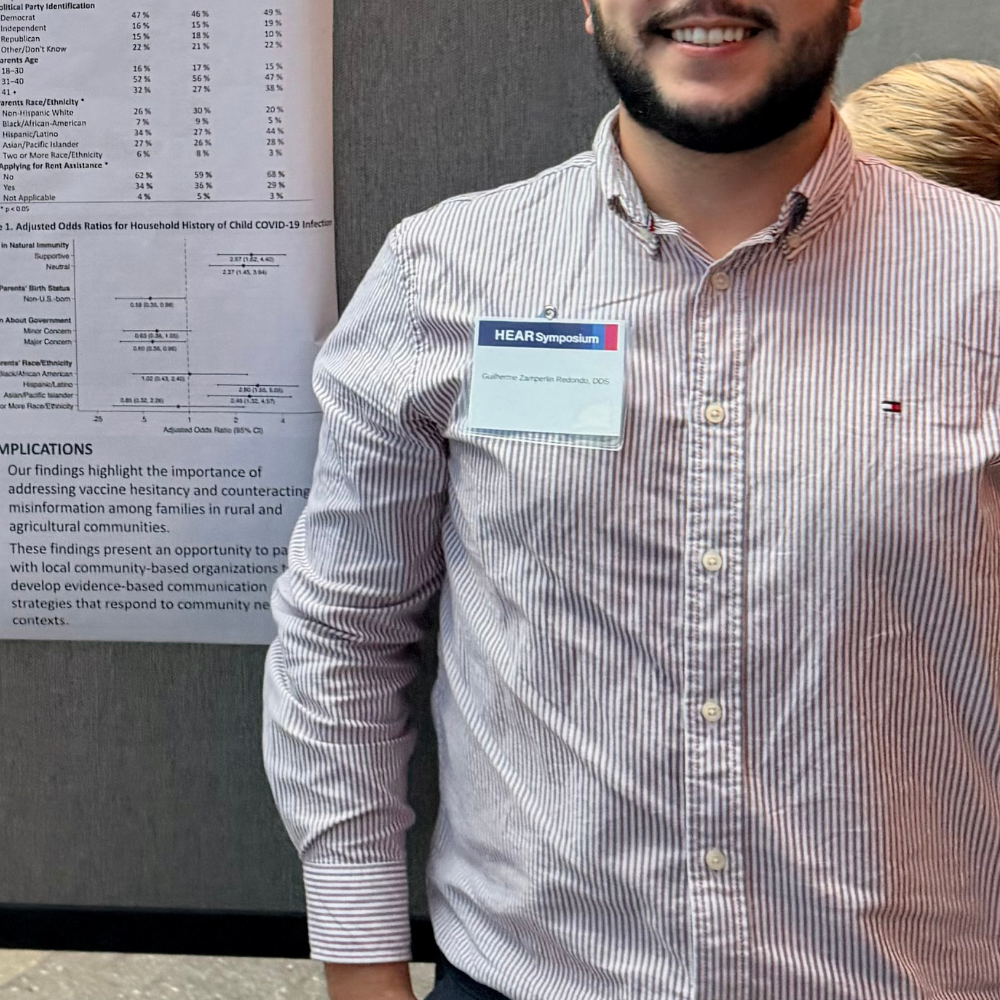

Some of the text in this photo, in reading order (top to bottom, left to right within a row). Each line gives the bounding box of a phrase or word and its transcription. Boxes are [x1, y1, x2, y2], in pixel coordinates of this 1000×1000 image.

[24, 3, 45, 12] Party
[45, 2, 96, 10] Identification
[494, 329, 600, 345] HEAR Symposium
[7, 463, 262, 480] Our findings highlight the importance of
[8, 482, 310, 500] addressing vaccine hesitancy and counteracting
